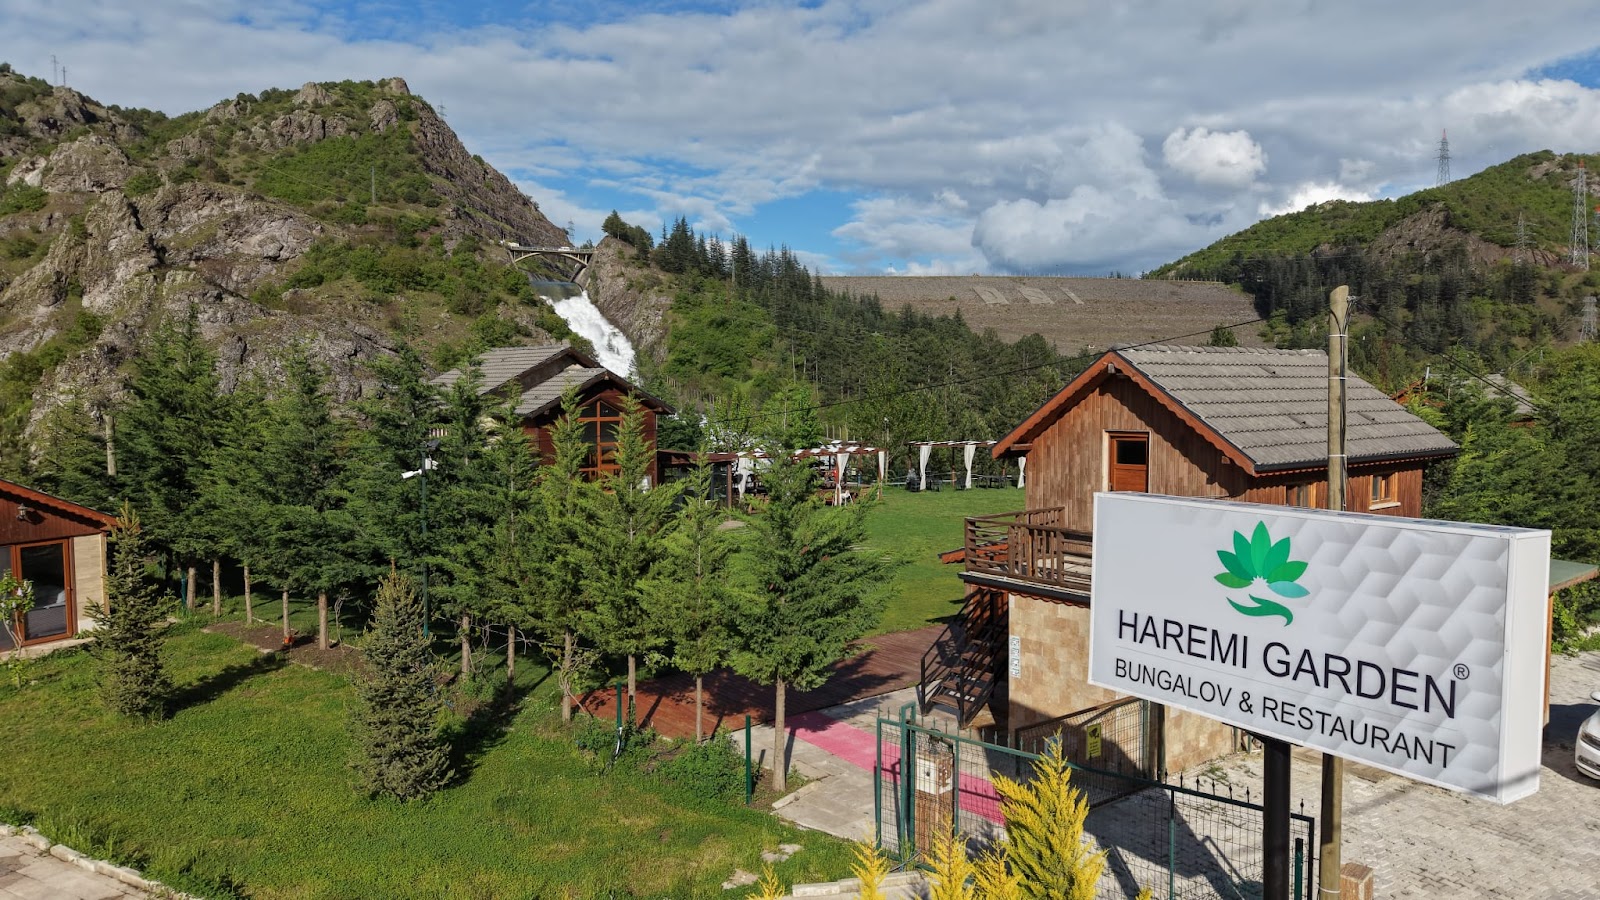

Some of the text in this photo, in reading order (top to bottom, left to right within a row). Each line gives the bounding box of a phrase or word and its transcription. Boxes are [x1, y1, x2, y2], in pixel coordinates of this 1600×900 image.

[1118, 610, 1248, 669] HAREMI
[1115, 658, 1456, 769] BUNGALOV & RESTAURANT
